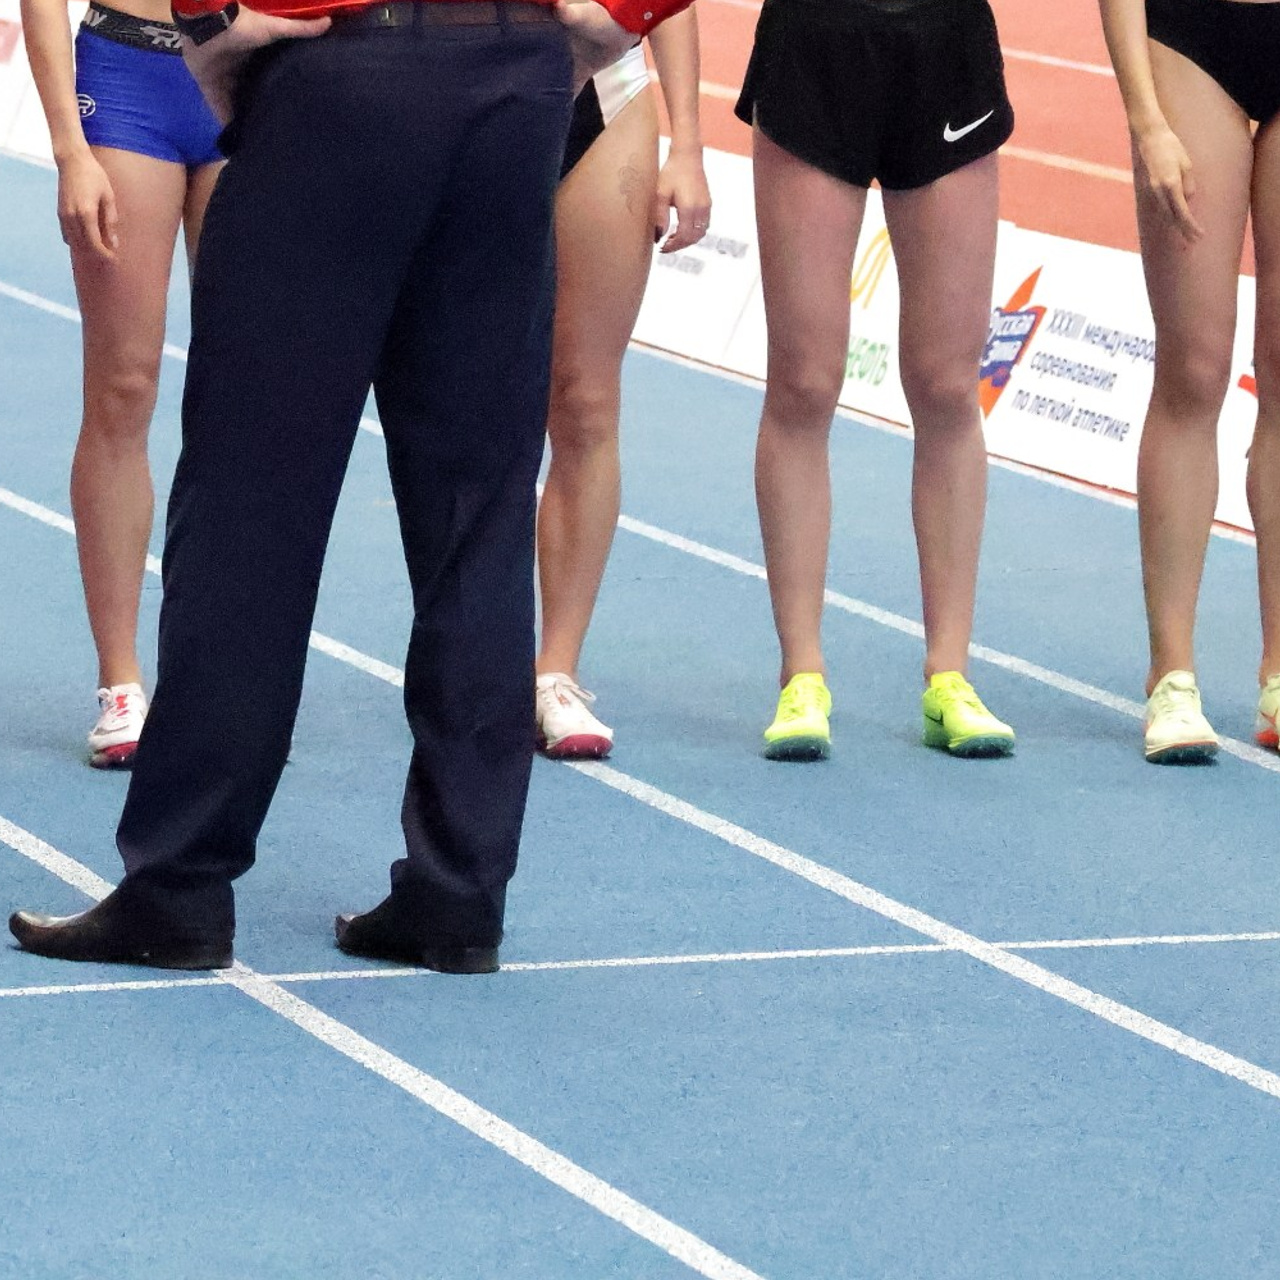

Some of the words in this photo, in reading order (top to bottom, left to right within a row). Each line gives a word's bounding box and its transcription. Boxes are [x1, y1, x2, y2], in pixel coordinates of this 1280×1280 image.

[1030, 351, 1117, 392] соревнования
[1011, 389, 1030, 410] по
[1027, 394, 1075, 424] легкой
[1072, 407, 1130, 441] атлетике
